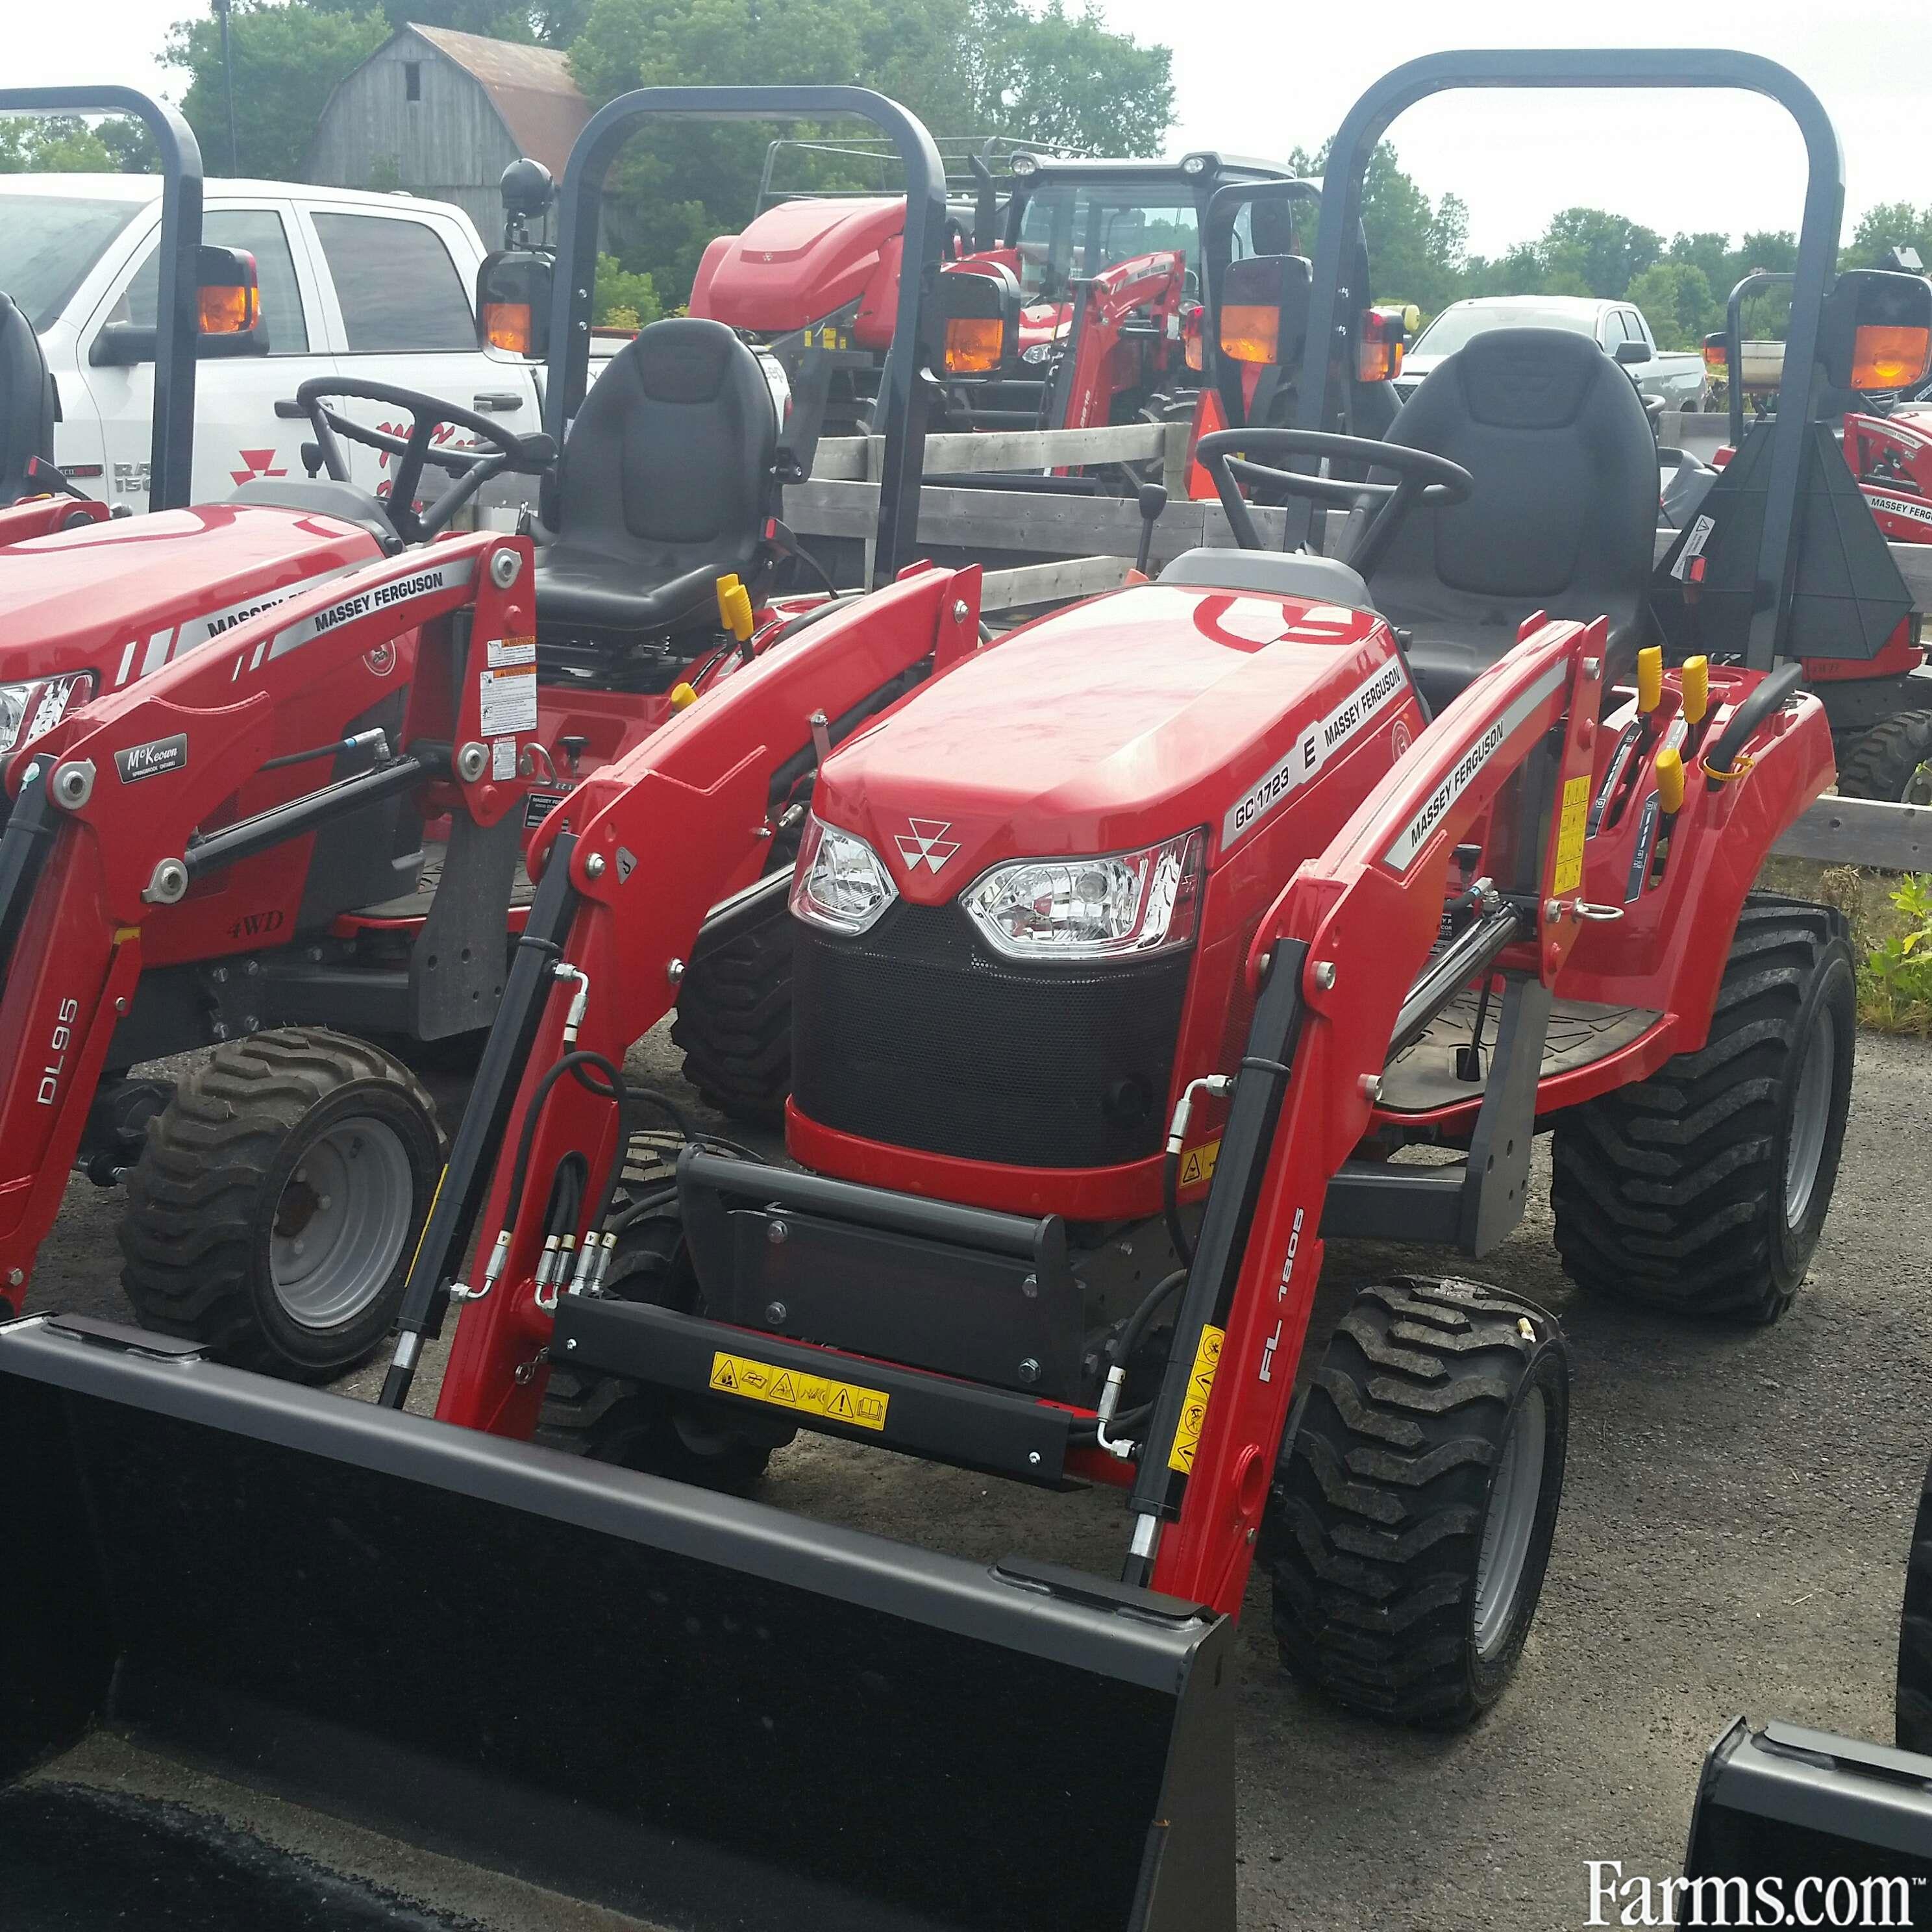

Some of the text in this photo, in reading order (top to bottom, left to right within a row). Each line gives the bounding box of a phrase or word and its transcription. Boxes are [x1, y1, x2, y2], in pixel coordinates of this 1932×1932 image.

[1871, 498, 1932, 521] MASSEY FERG
[315, 572, 443, 632] MASSEY FERGUSON
[127, 746, 177, 771] McKeown
[1235, 665, 1401, 829] GC 1723 E MASSEY FERGUSON
[1411, 721, 1503, 847] MASSEY FERGUSON
[227, 910, 284, 938] 4WD
[37, 998, 78, 1104] DL95
[1259, 1208, 1304, 1383] FL 1805
